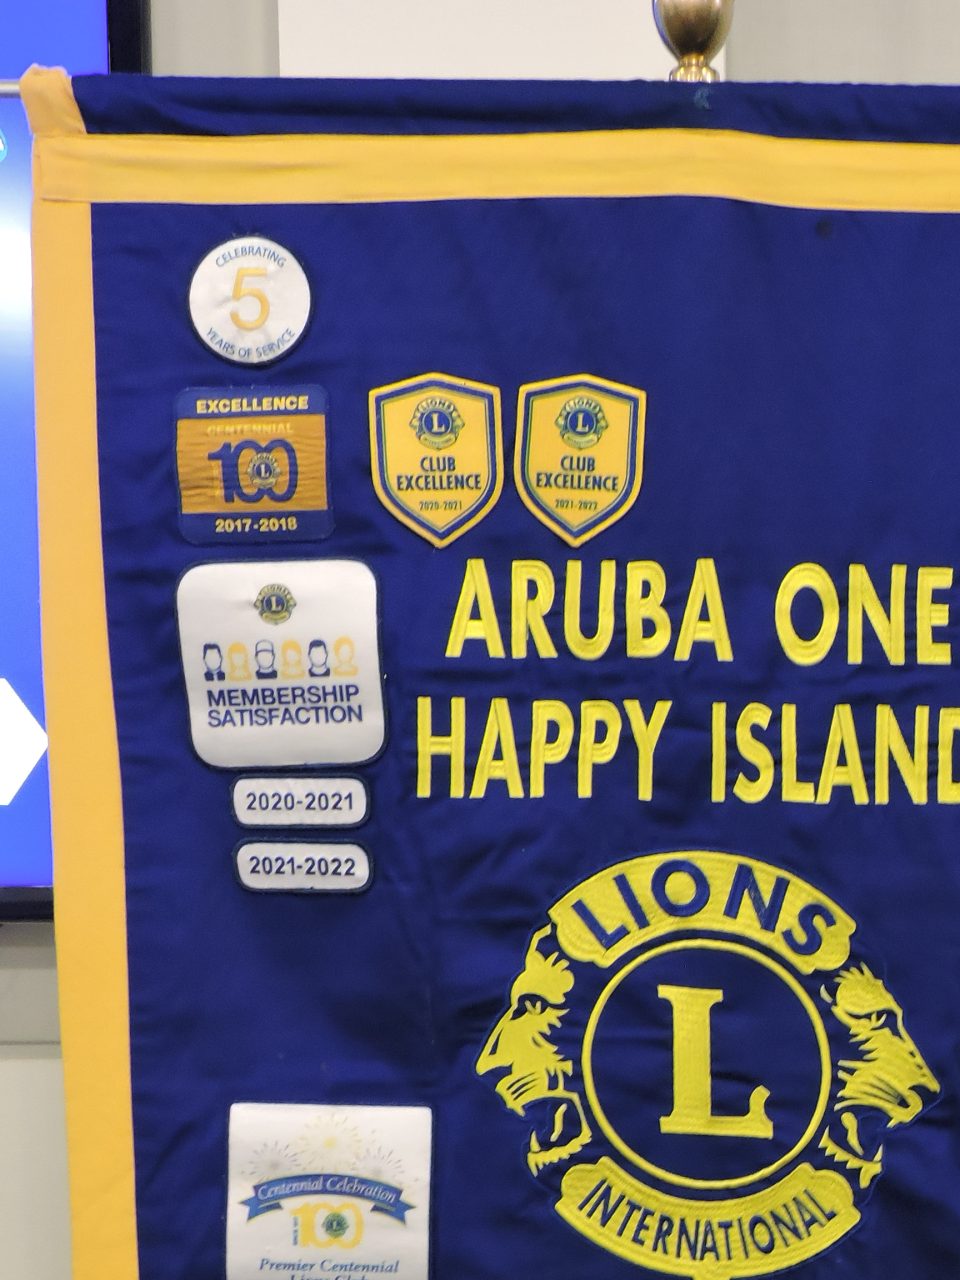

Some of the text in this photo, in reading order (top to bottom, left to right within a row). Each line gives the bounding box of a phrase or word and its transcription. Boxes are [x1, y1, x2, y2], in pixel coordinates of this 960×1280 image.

[215, 246, 287, 268] CELEBRATING
[230, 267, 270, 332] 5
[206, 327, 296, 359] YEARS OF SERVICE
[196, 395, 309, 414] EXCELLENCE
[207, 423, 294, 436] CENTENNIAL
[431, 412, 446, 433] L
[575, 412, 589, 432] L
[207, 438, 299, 503] 100
[420, 456, 456, 472] CLUB
[560, 455, 596, 472] CLUB
[396, 474, 482, 491] EXCELLENCE
[536, 472, 620, 492] EXCELLENCE
[419, 501, 463, 511] 2020-2021
[555, 499, 598, 511] 2021-2022
[215, 516, 298, 533] 2017-2018
[445, 558, 954, 666] ARUBA ONE
[206, 684, 360, 708] MEMBERSHIP
[207, 704, 363, 728] SATISFACTION
[416, 696, 673, 802] HAPPY
[246, 792, 353, 811] 2020-2021
[249, 856, 356, 876] 2021-2022
[571, 859, 837, 957] LIONS
[657, 984, 774, 1140] L
[257, 1176, 397, 1204] Centennial Celebration
[289, 1202, 365, 1250] 100
[578, 1178, 838, 1261] INTERNATIONAL
[259, 1258, 400, 1274] Premier Centennial
